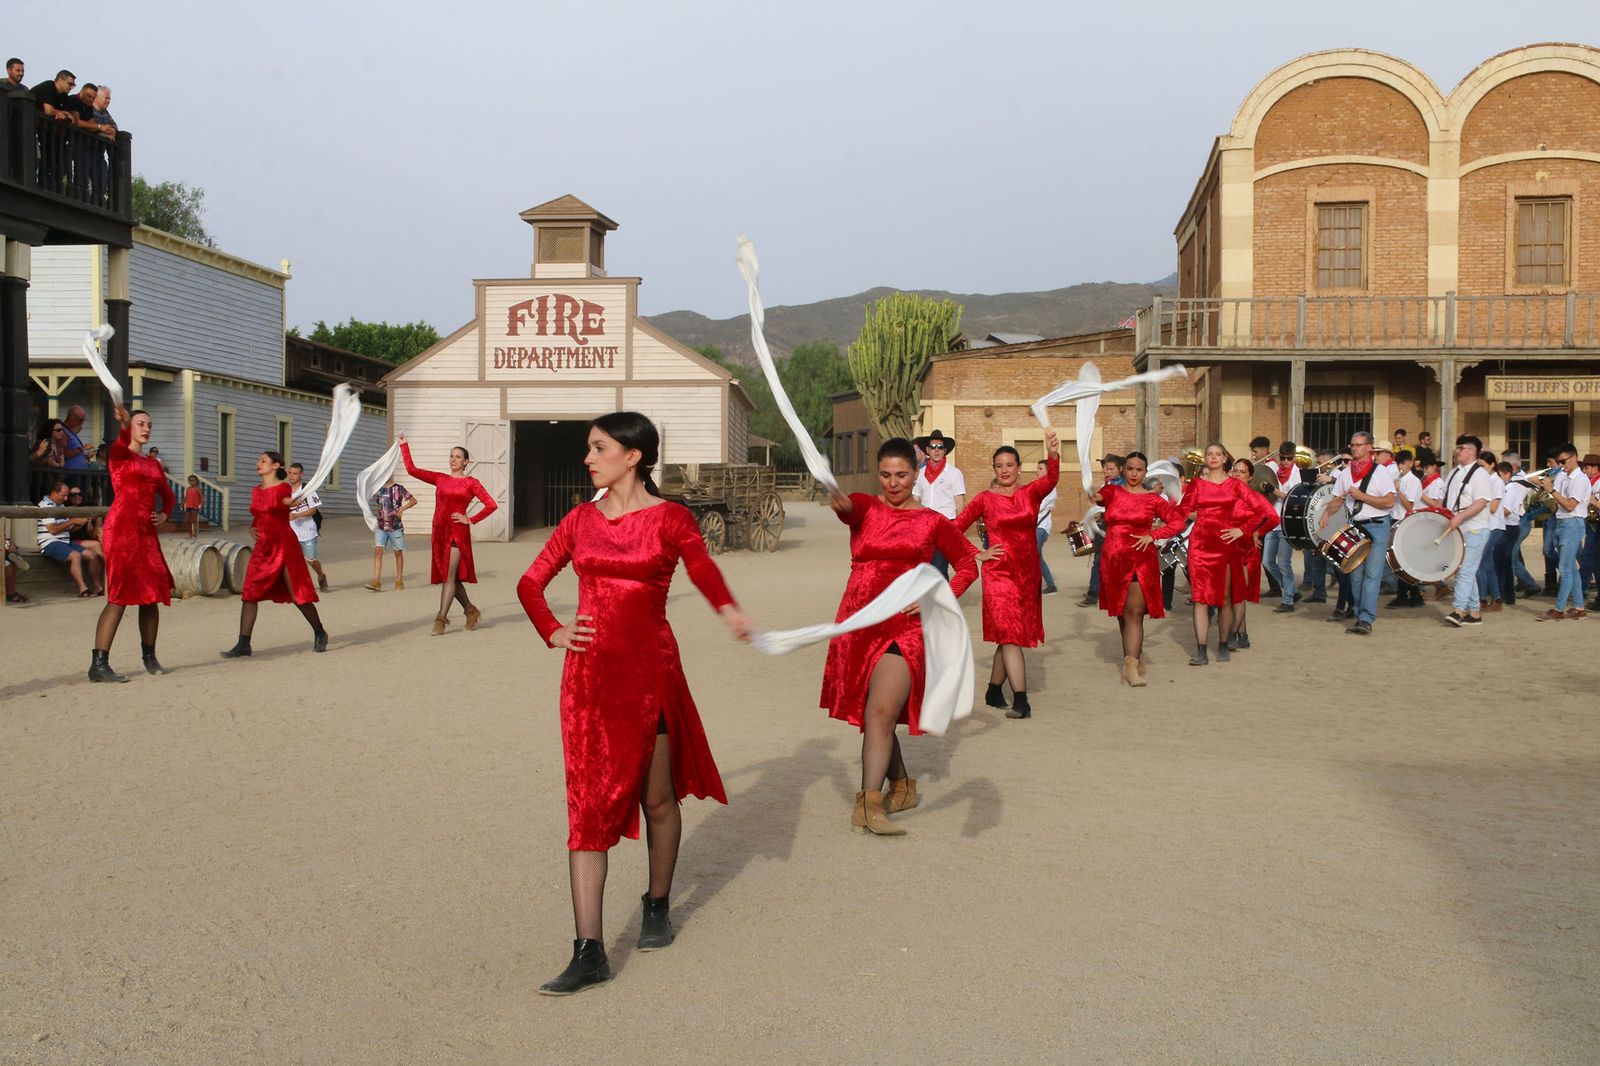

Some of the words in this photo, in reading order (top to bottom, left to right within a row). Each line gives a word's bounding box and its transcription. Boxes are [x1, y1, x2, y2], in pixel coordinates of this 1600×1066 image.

[506, 293, 606, 345] FIRE
[494, 346, 619, 373] DEPARTMENT
[1494, 381, 1570, 393] SHERIFF'S
